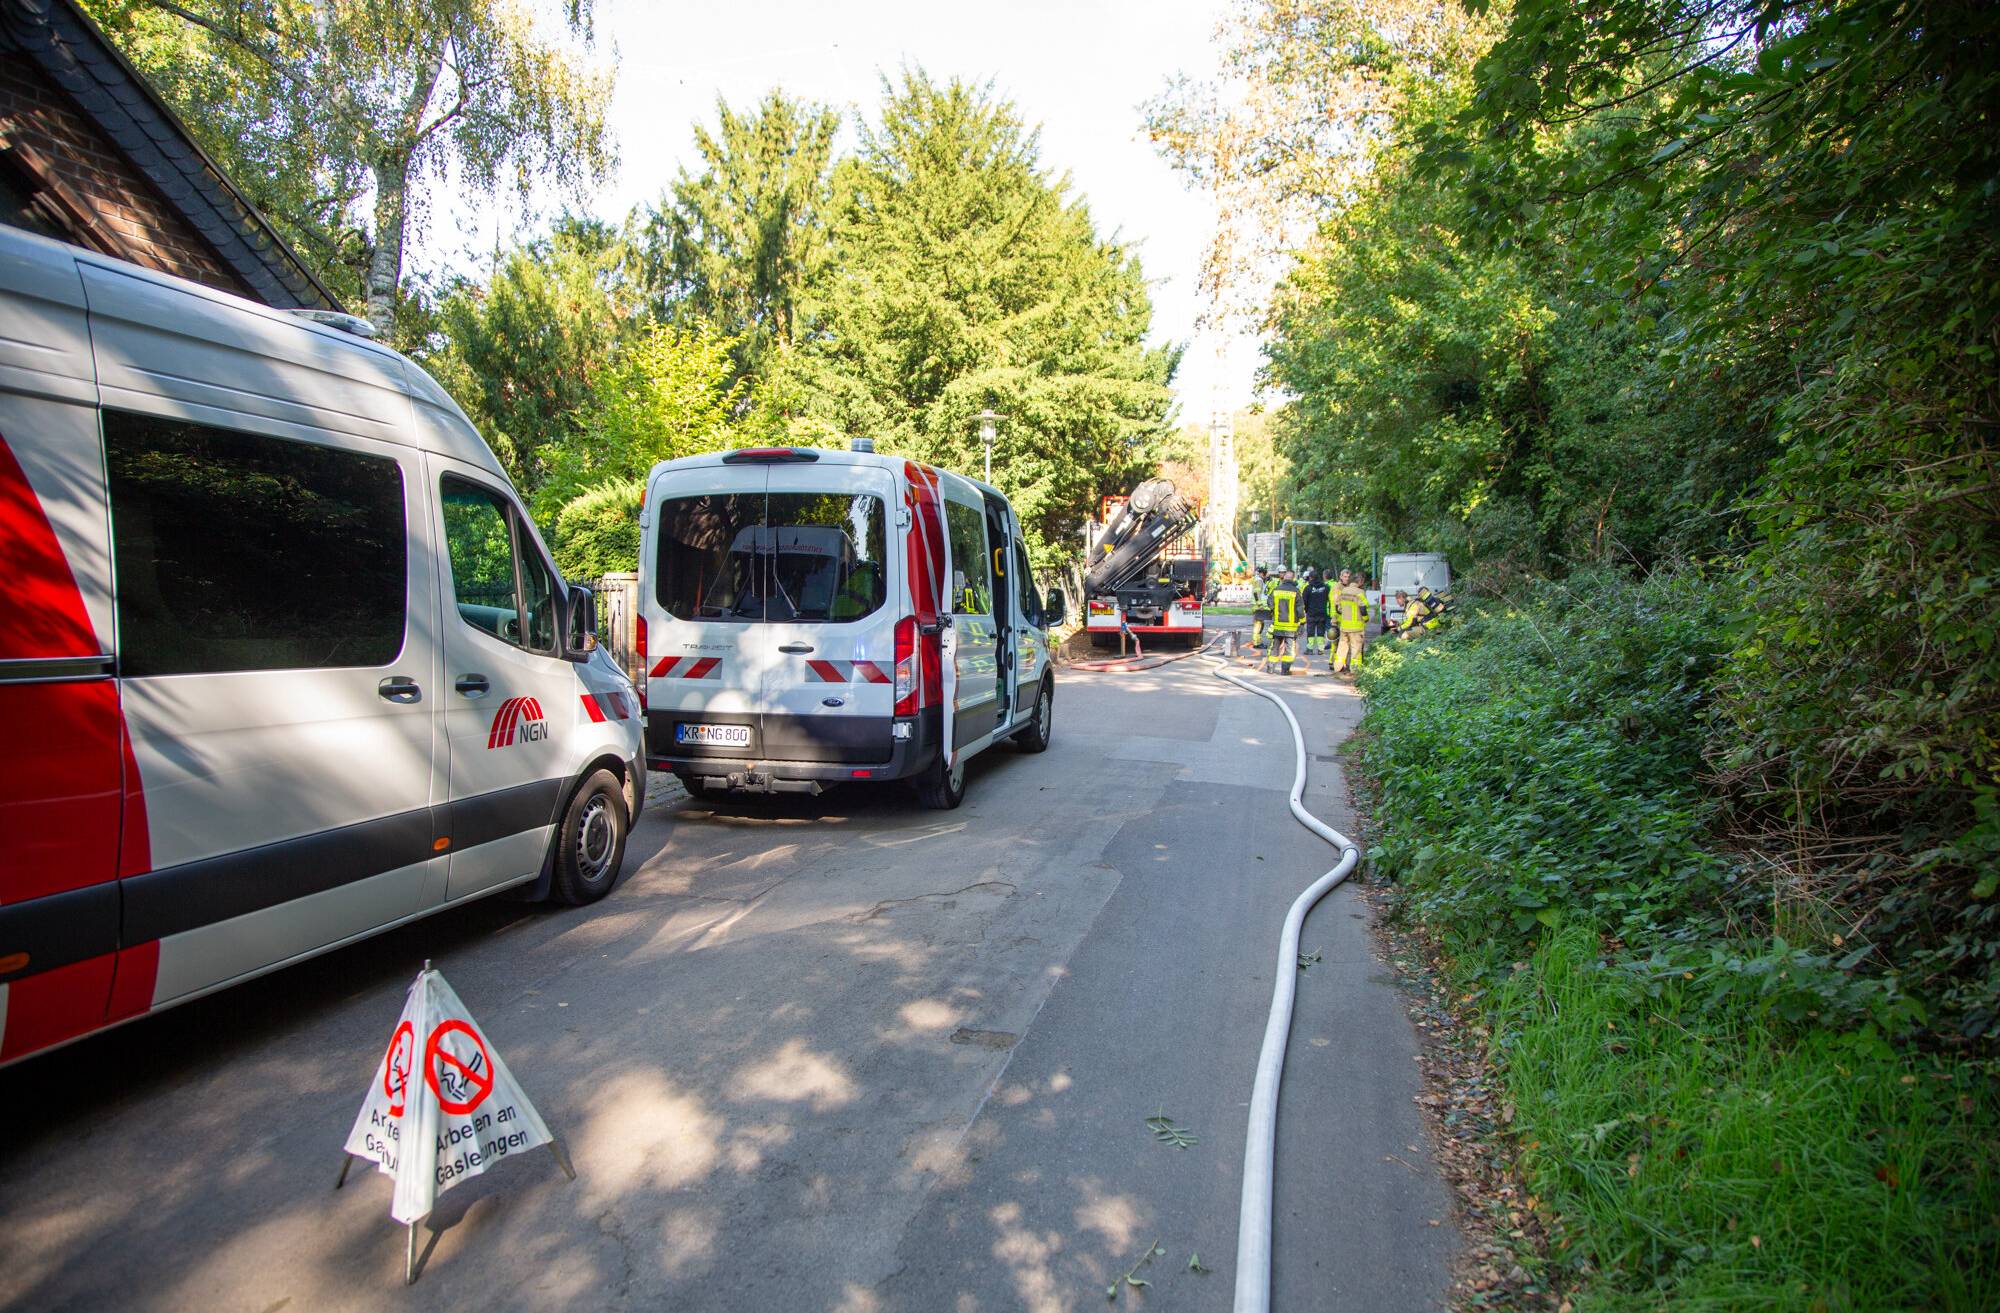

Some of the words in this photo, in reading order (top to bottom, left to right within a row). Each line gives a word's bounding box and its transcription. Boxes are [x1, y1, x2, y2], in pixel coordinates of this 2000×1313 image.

[519, 721, 548, 744] NGN
[684, 726, 699, 740] KR
[706, 727, 723, 741] NG
[725, 728, 748, 742] 800
[436, 1113, 492, 1155] Arbeen
[497, 1105, 517, 1123] an
[435, 1130, 529, 1186] Gasleungen
